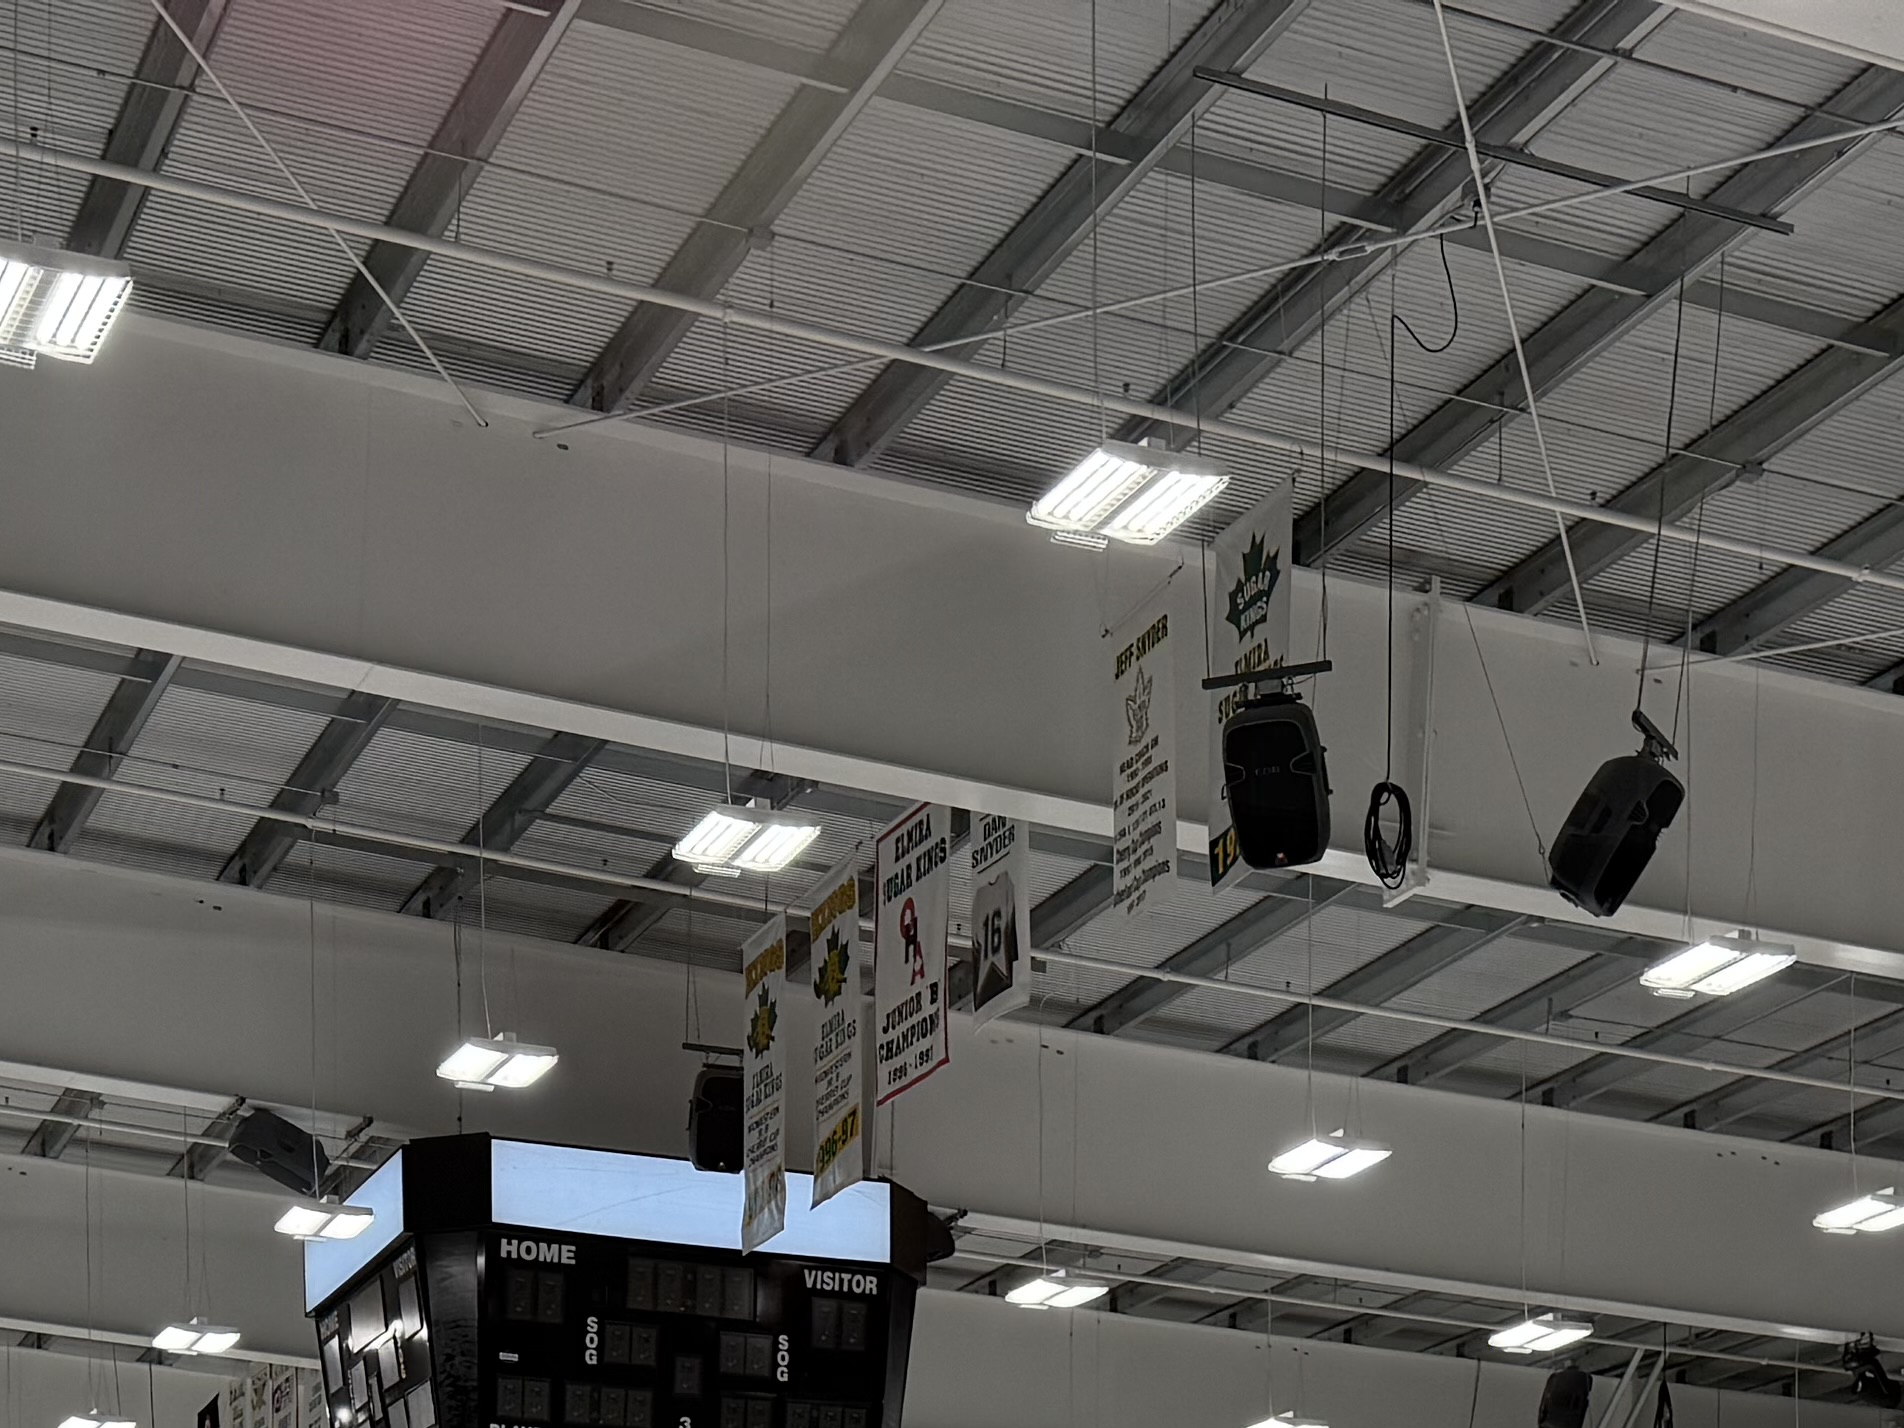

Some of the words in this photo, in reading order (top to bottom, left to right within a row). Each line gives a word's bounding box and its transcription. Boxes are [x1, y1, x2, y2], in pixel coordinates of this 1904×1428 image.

[1115, 643, 1135, 680] JEFF
[1136, 614, 1168, 663] SNYDER
[895, 814, 932, 864] ELMIRA
[972, 824, 1015, 869] SNYDER
[984, 814, 1006, 842] DAN
[915, 837, 947, 882] KINGS
[983, 908, 1002, 960] 16
[882, 990, 922, 1035] JUNIOR
[500, 1238, 576, 1265] HOME
[804, 1269, 878, 1295] VISITOR
[585, 1316, 598, 1365] SOG
[776, 1335, 789, 1382] SOG
